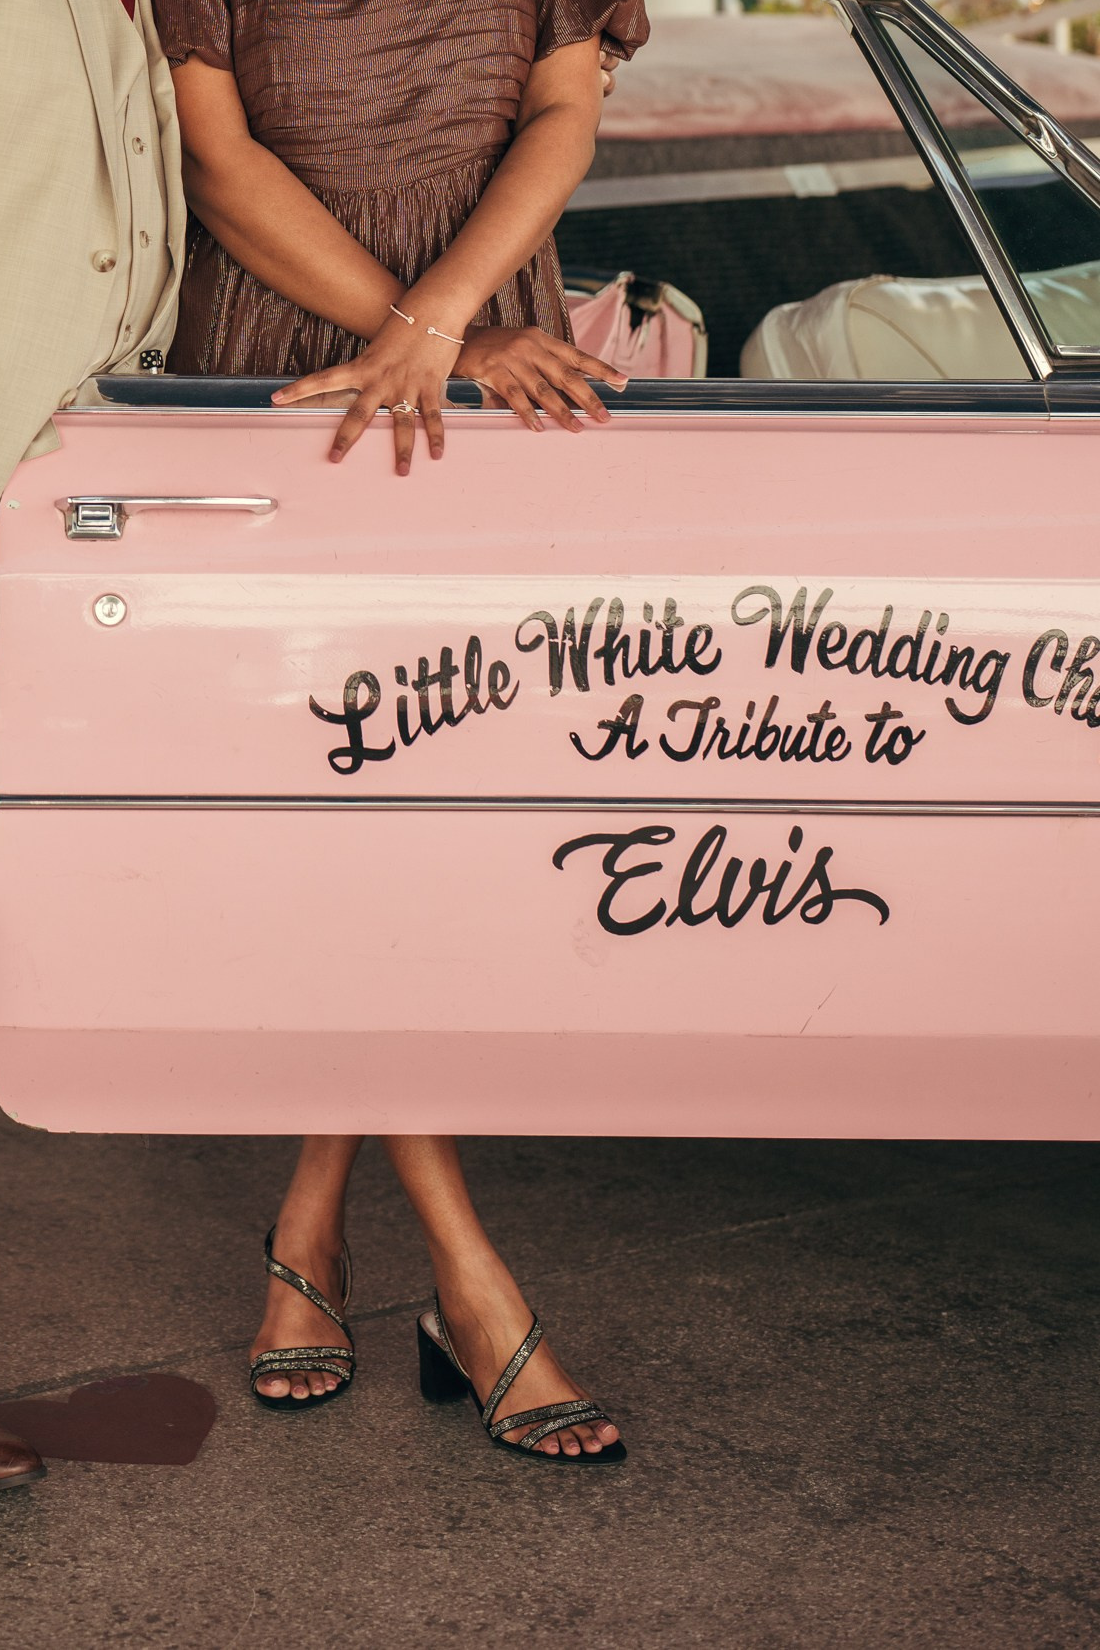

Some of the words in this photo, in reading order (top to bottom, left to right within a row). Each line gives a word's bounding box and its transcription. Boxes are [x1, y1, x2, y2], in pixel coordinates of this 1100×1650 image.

[309, 636, 519, 776] Little
[515, 596, 723, 697] White
[731, 585, 1011, 726] Wedding
[569, 694, 649, 762] A
[658, 695, 852, 764] Tribute
[864, 701, 927, 765] to
[552, 825, 891, 937] Elvis
